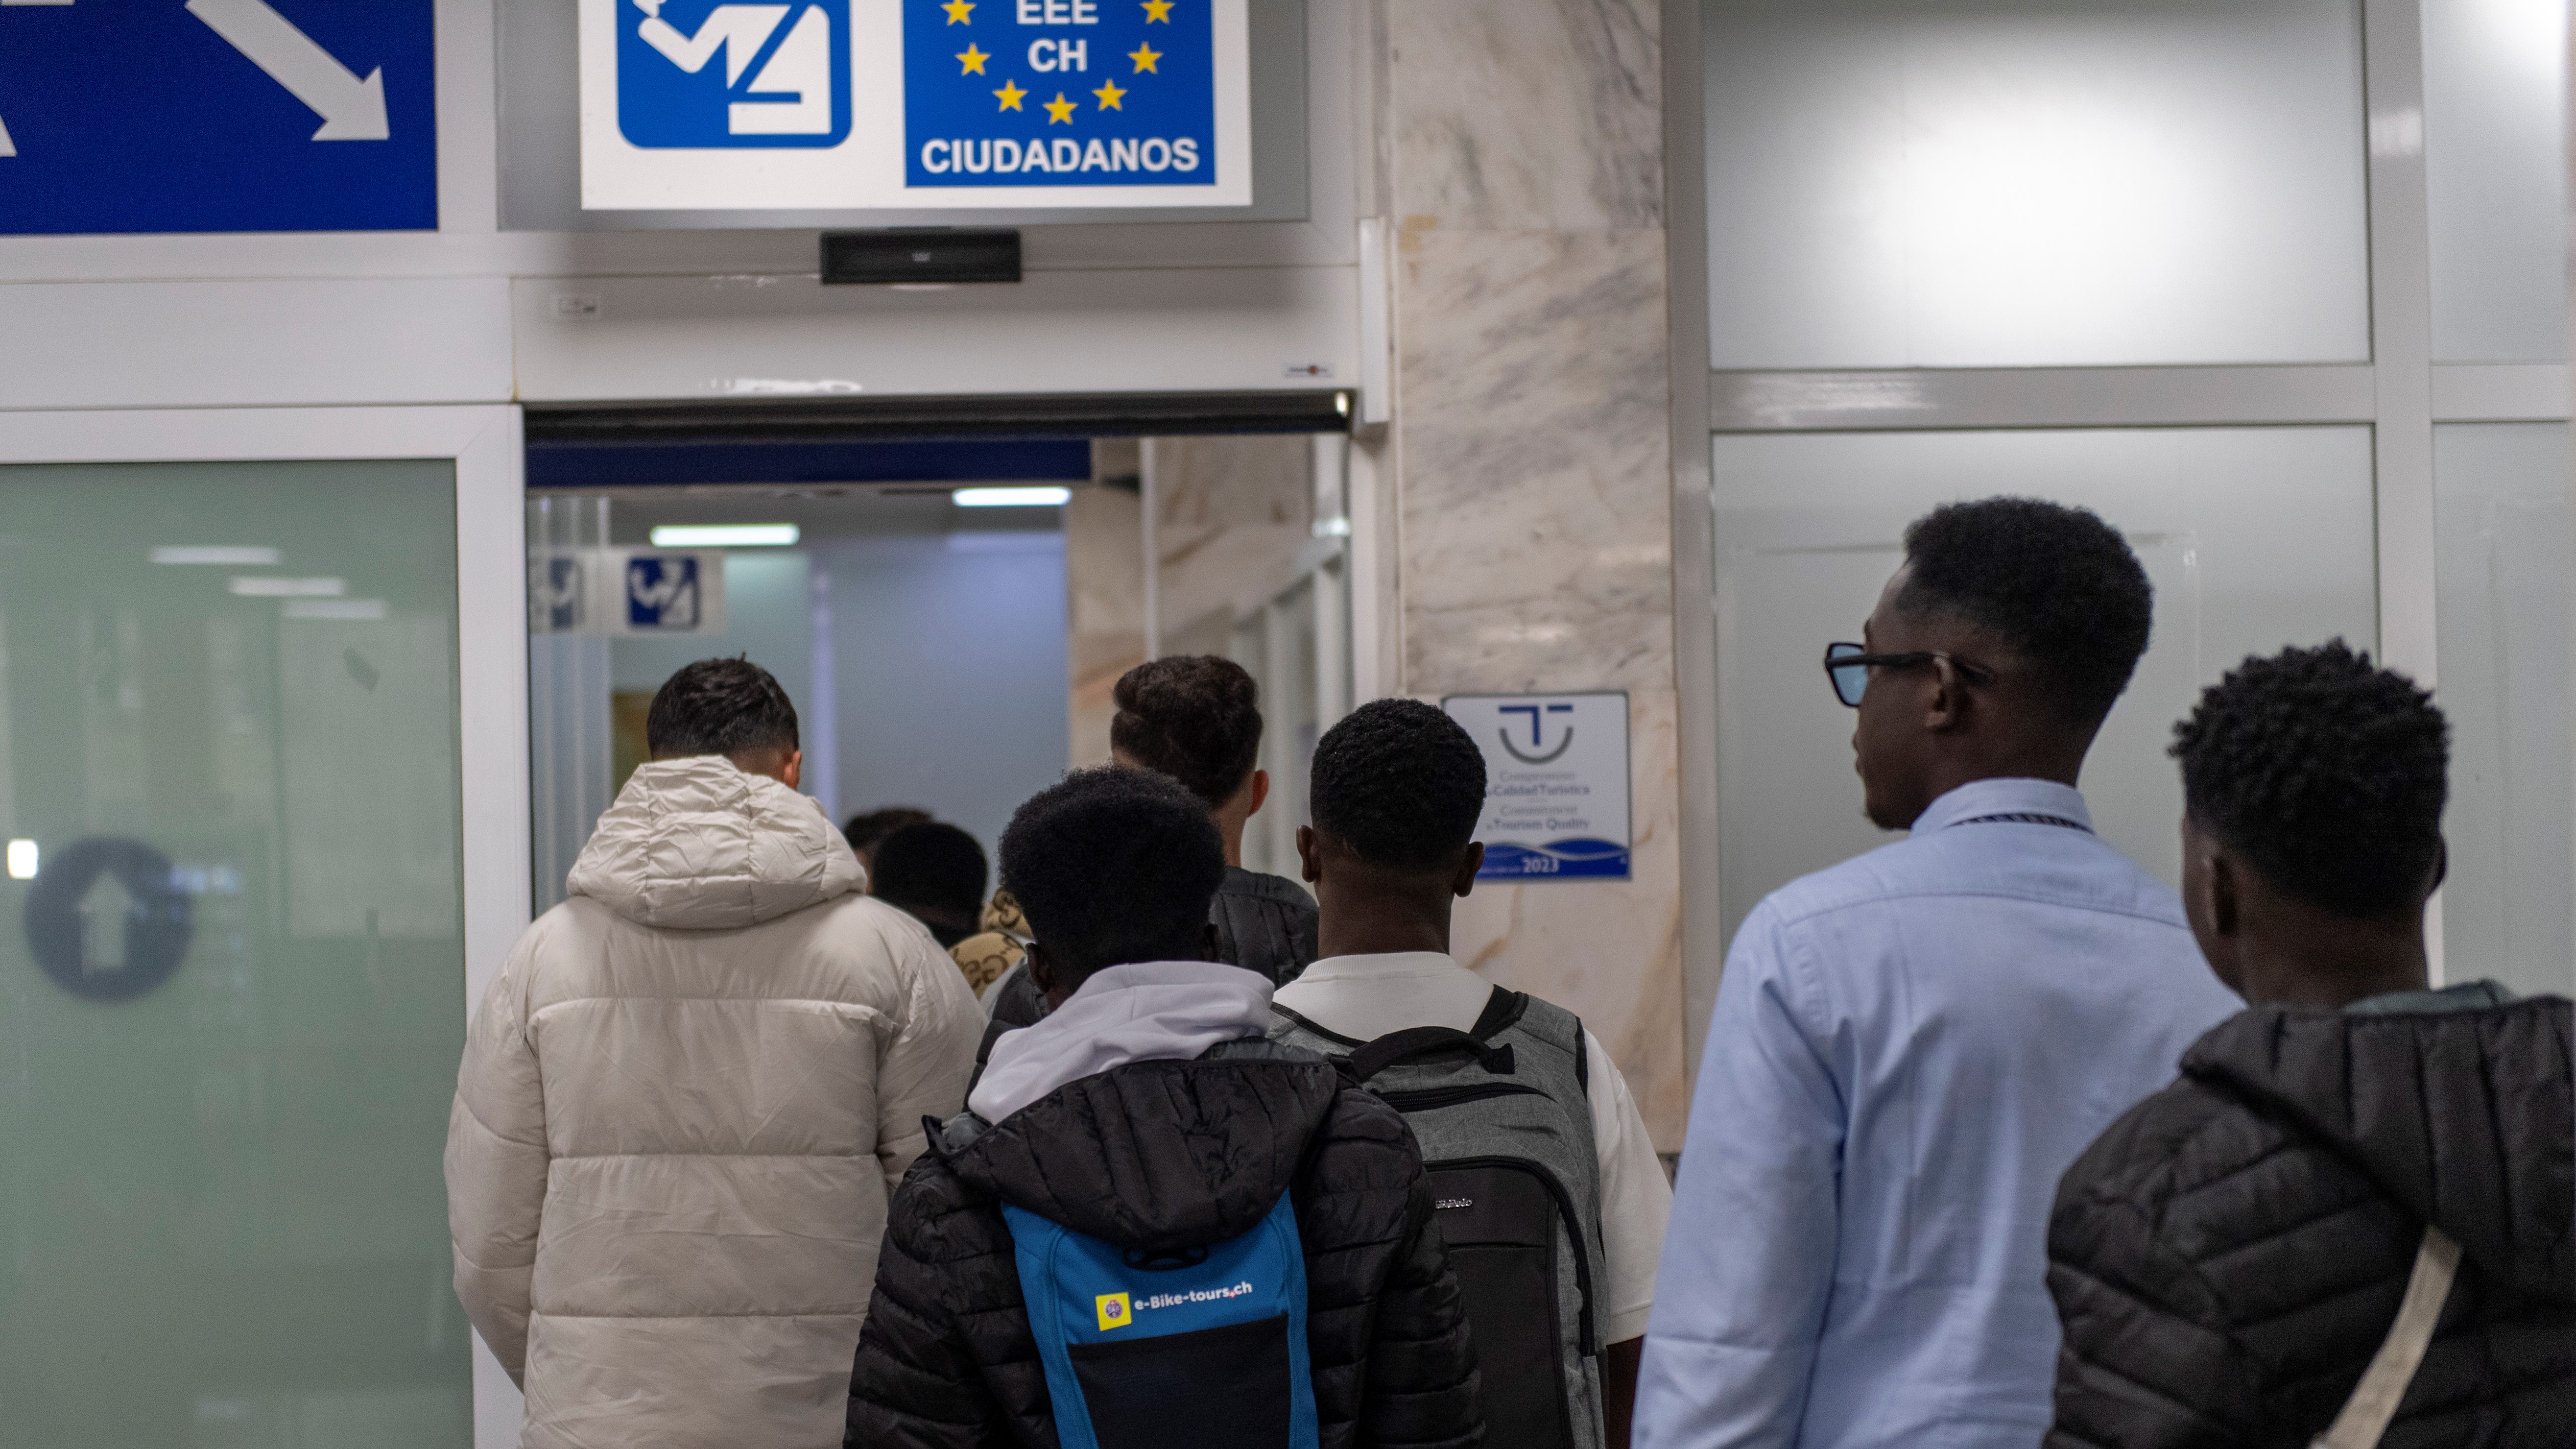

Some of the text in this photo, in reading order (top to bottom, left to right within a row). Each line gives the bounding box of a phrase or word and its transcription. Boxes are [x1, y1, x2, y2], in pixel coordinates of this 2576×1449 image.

[1016, 0, 1099, 24] EEE
[1028, 39, 1087, 72] CH
[921, 137, 1199, 173] CIUDADANOS
[1546, 817, 1589, 832] Quality
[1522, 857, 1560, 873] 2023
